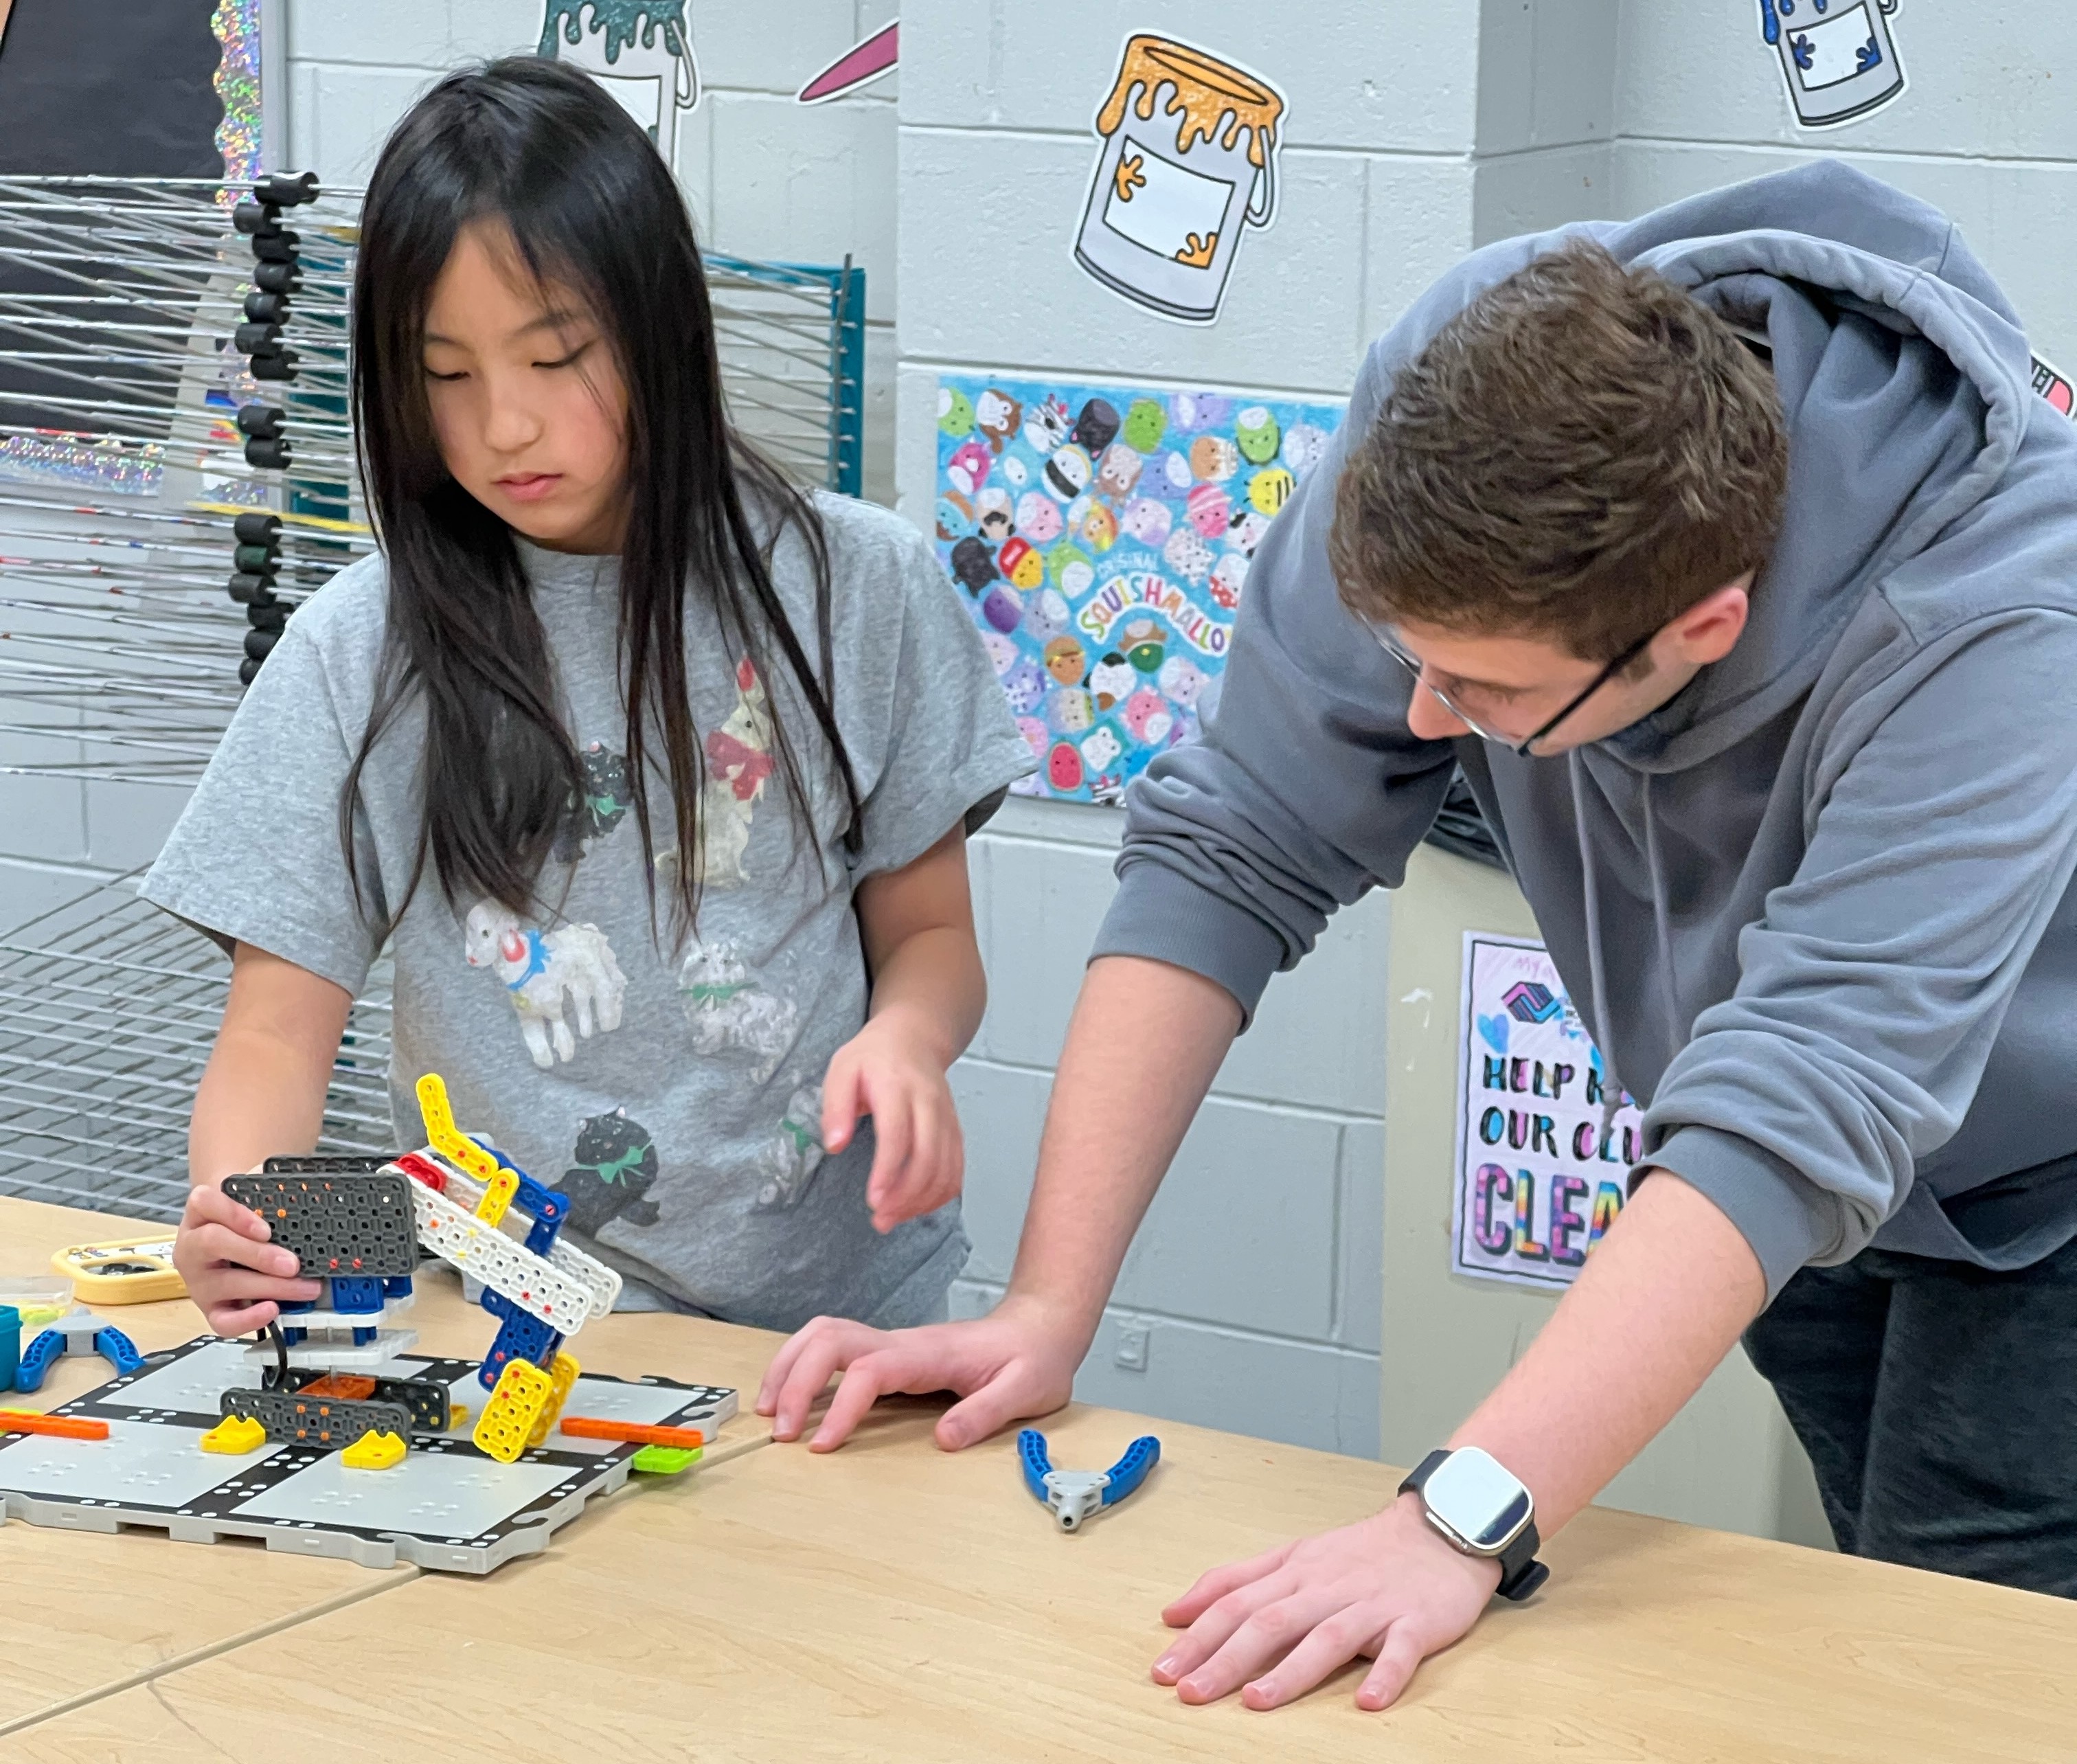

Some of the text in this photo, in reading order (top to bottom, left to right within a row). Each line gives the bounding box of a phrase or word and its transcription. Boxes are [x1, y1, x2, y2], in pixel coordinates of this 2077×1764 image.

[1080, 576, 1234, 653] SQUISHMALLO
[1482, 1054, 1576, 1100] HELP
[1479, 1106, 1644, 1166] OUR CLU
[1473, 1162, 1624, 1268] CLEA
